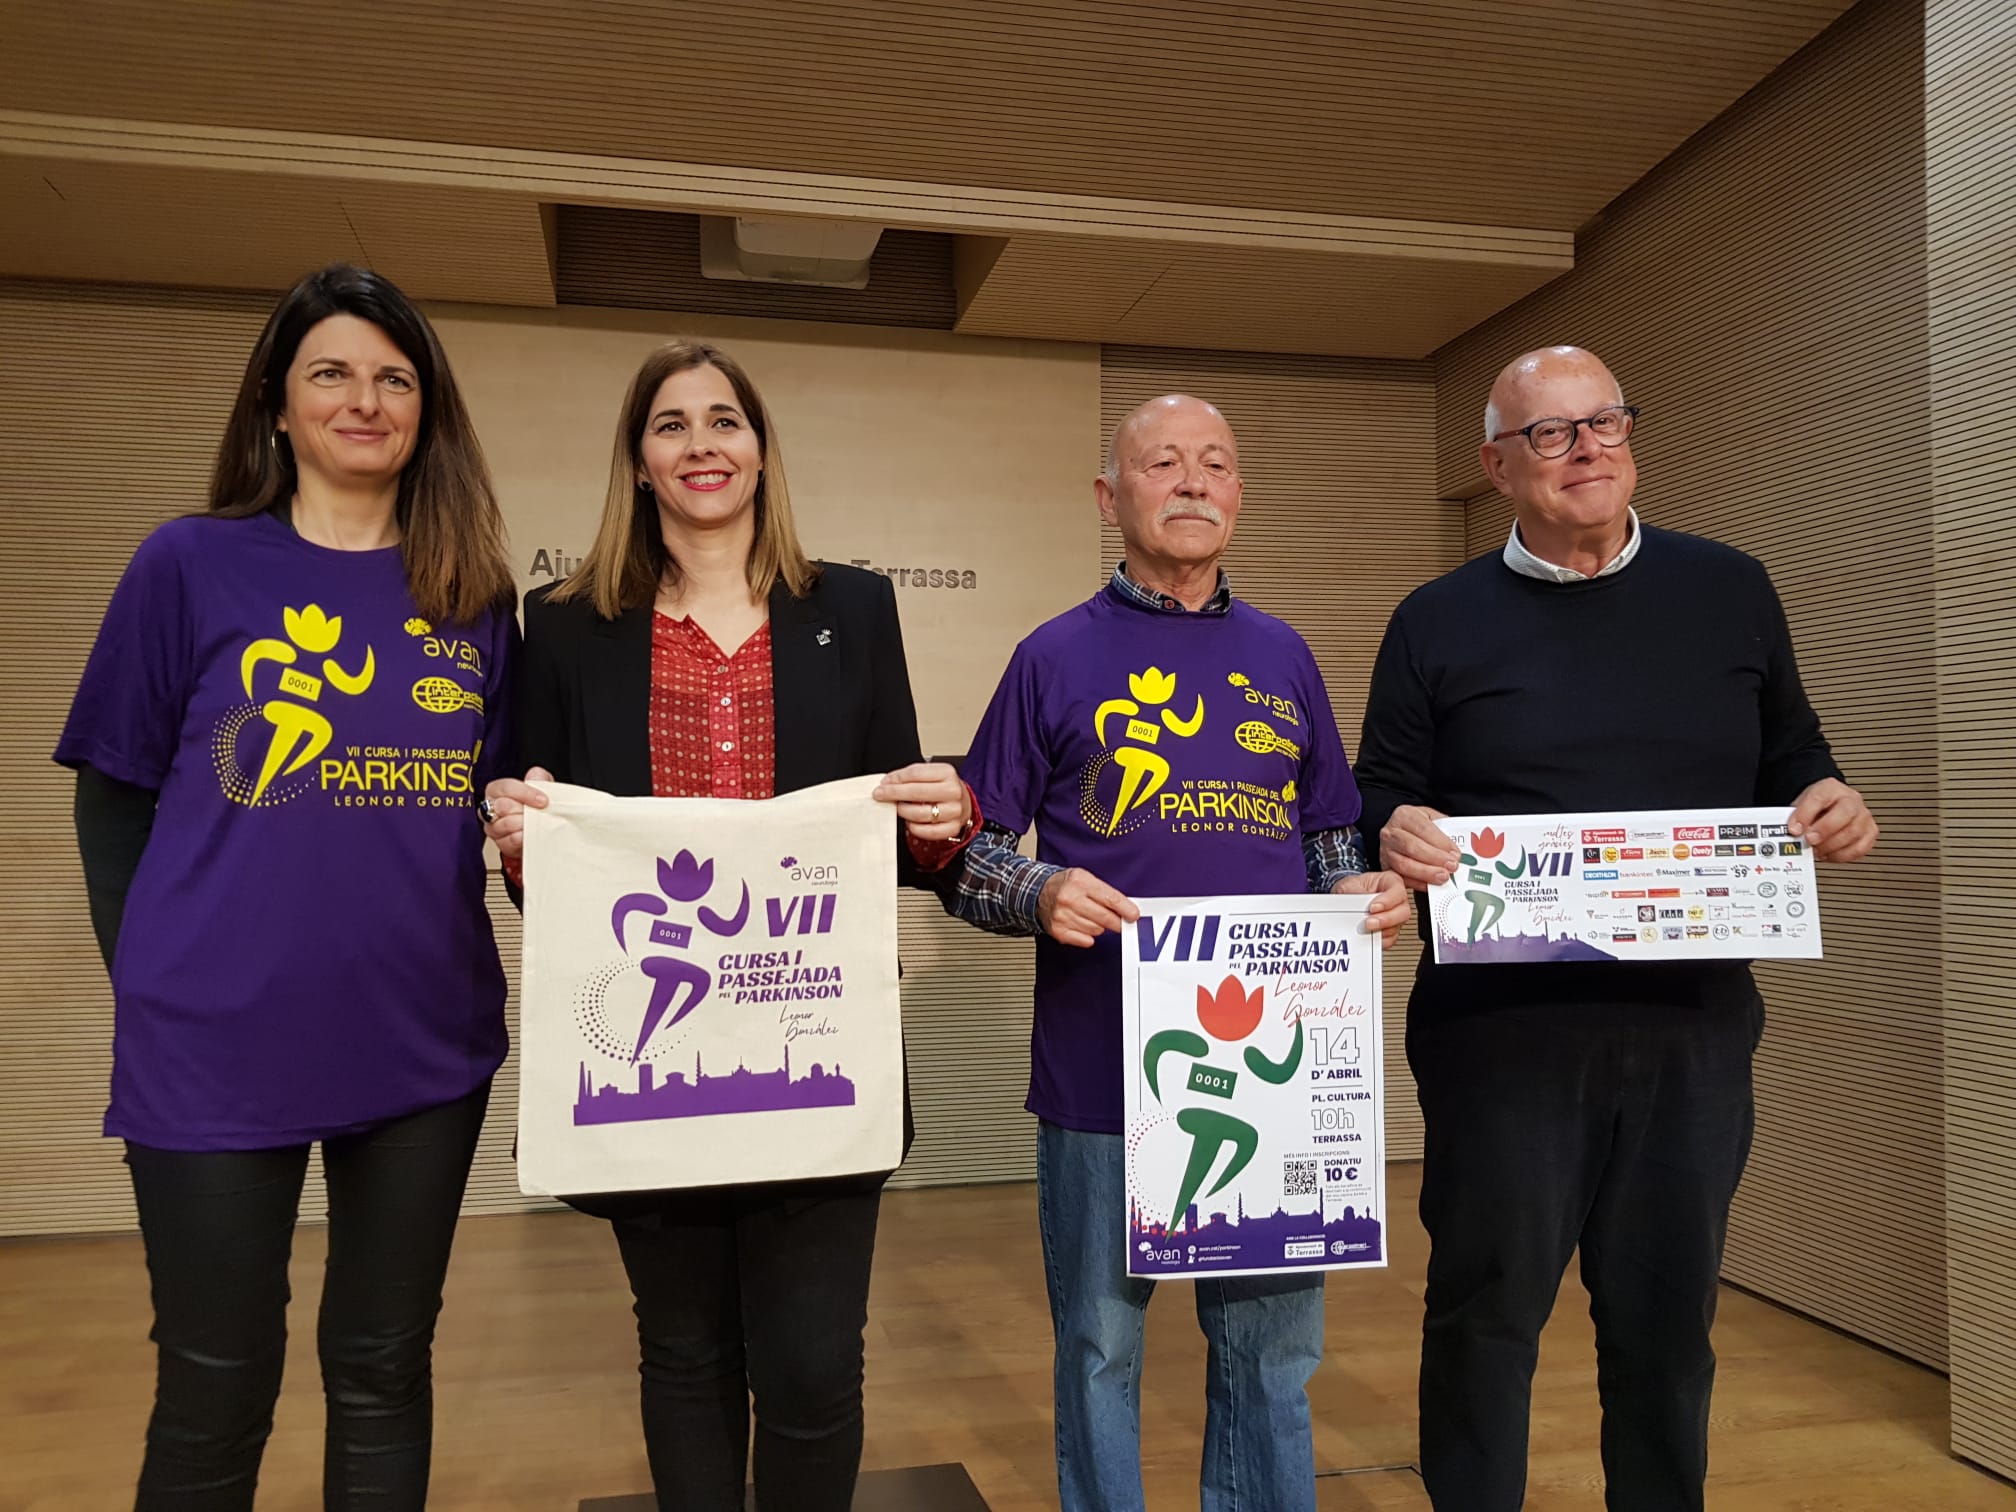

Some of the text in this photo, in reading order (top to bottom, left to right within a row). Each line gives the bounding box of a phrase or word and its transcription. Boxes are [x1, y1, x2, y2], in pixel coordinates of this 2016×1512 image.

[423, 637, 481, 669] avan
[288, 676, 313, 693] 0001
[1244, 687, 1297, 718] avan
[1131, 725, 1154, 738] 0001
[346, 746, 471, 760] VII CURSA I PASSEJADA
[320, 759, 475, 793] PARKINS
[1182, 780, 1281, 801] VII CURSA I PASSEJADA DEL
[334, 796, 405, 807] LEONOR
[1159, 791, 1293, 831] PARKINSON
[1172, 822, 1235, 833] LEONOR
[791, 865, 838, 881] avan
[1528, 852, 1574, 877] VII
[1735, 868, 1747, 878] 59
[1585, 871, 1617, 879] DECATHLON
[1504, 880, 1535, 889] CURSA
[1504, 888, 1559, 897] PASSEJADA
[765, 893, 837, 938] VII
[659, 928, 682, 941] 0001
[1136, 915, 1221, 962] VII
[1228, 921, 1311, 941] CURSA I
[1228, 939, 1350, 960] PASSEJADA
[718, 949, 803, 971] CURSA I
[1245, 958, 1351, 976] PARKINSON
[718, 965, 842, 990] PASSEJADA
[1274, 964, 1328, 998] Leonor
[735, 983, 843, 1005] PARKINSON
[779, 1004, 814, 1024] Leonor
[1283, 988, 1368, 1028] González
[1310, 1026, 1361, 1066] 14
[1195, 1072, 1229, 1090] 0001
[1327, 1068, 1363, 1080] ABRIL
[1311, 1092, 1372, 1103] PL. CULTURA
[1311, 1107, 1355, 1131] 10h
[1312, 1133, 1362, 1145] TERRASSA
[1324, 1157, 1362, 1167] DONATIU
[1324, 1166, 1358, 1182] 10 €
[1146, 1248, 1181, 1262] avan
